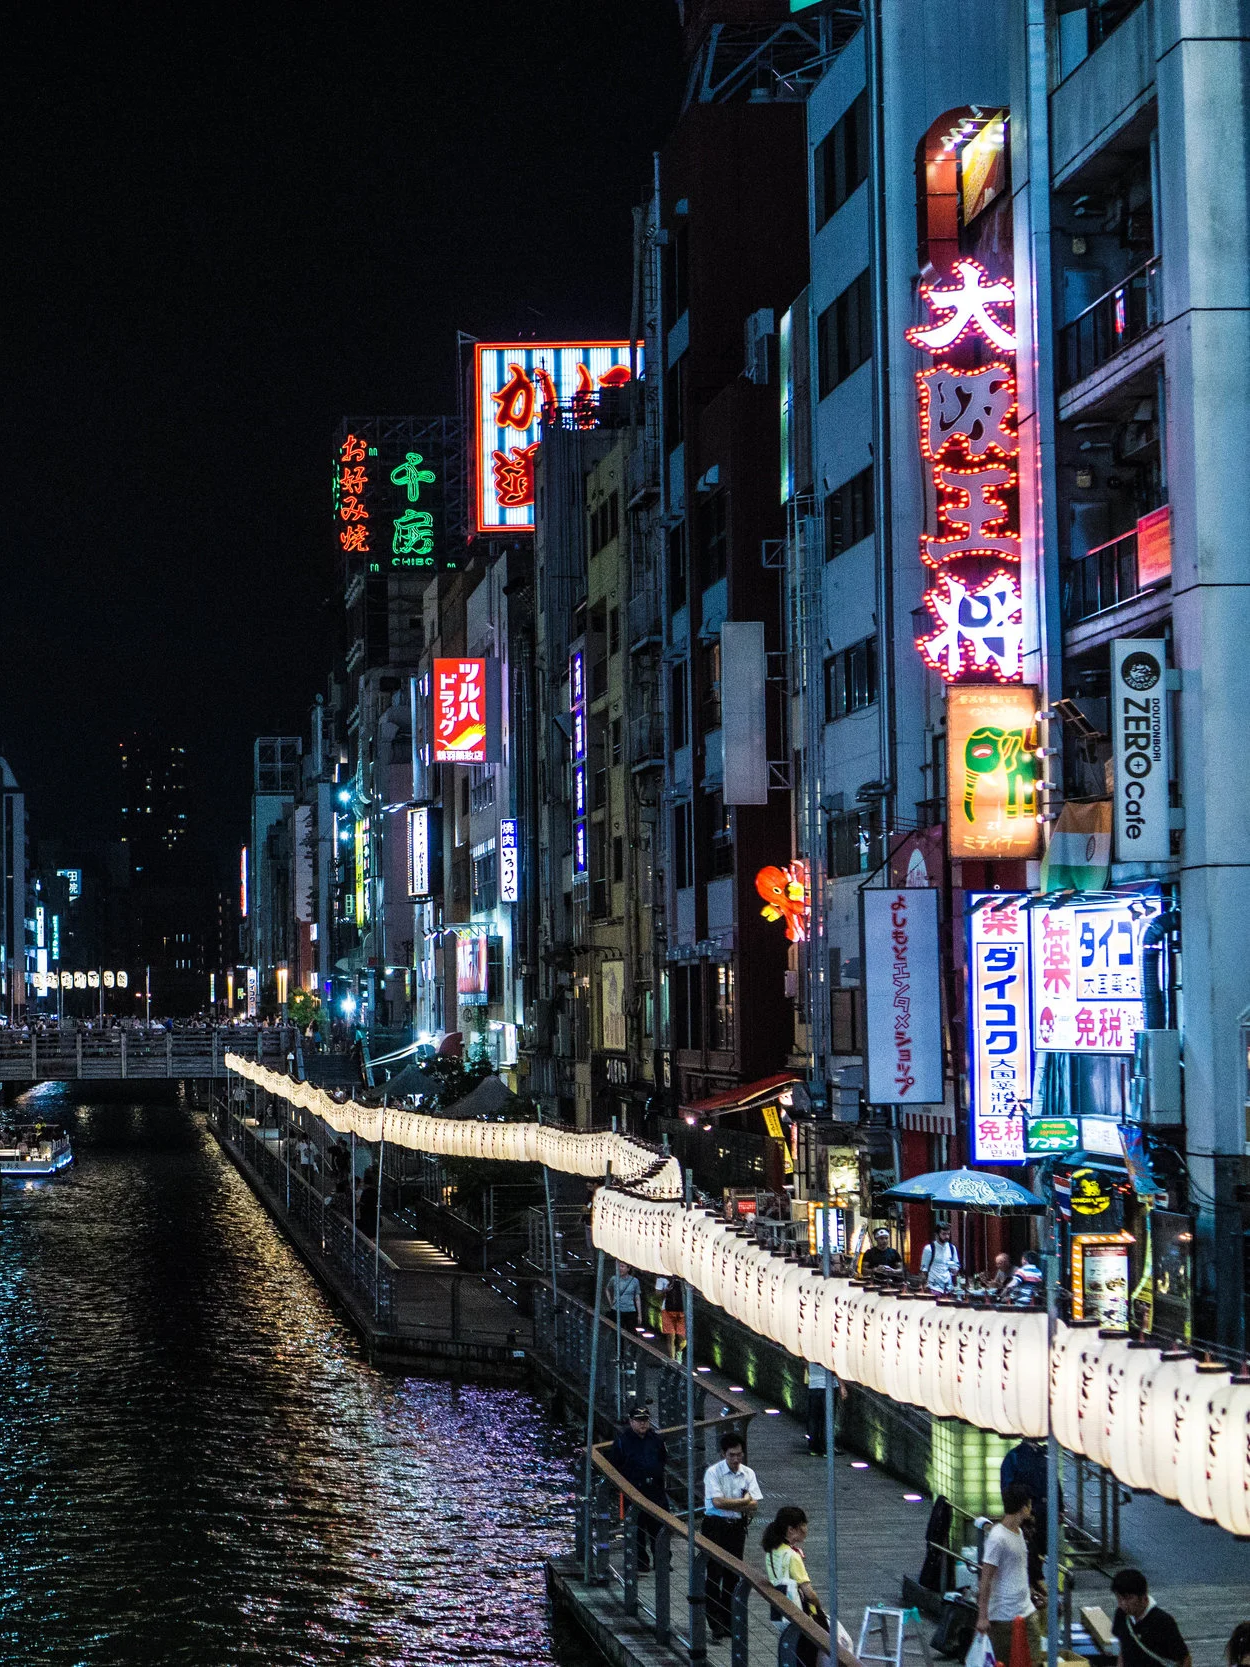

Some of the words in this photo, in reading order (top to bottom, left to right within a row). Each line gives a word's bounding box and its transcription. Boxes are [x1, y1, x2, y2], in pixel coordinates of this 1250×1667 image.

[340, 434, 369, 552] お好み焼
[905, 257, 1021, 683] 大阪王将
[390, 452, 436, 555] 千房
[439, 673, 458, 737] ドラッグ
[458, 663, 481, 722] ツルハ
[1123, 697, 1152, 779] ZERO
[1151, 698, 1161, 762] DOUTONBORI
[502, 821, 515, 847] 焼肉
[962, 834, 1031, 851] ミティラー
[502, 850, 515, 900] いろりや
[983, 897, 1018, 936] 薬
[1079, 919, 1142, 968] ダイコ
[890, 895, 916, 1096] よしもとエンタメショップ
[984, 946, 1018, 1055] ダイコク
[1075, 1007, 1123, 1047] 免税
[978, 1120, 1024, 1141] 免税
